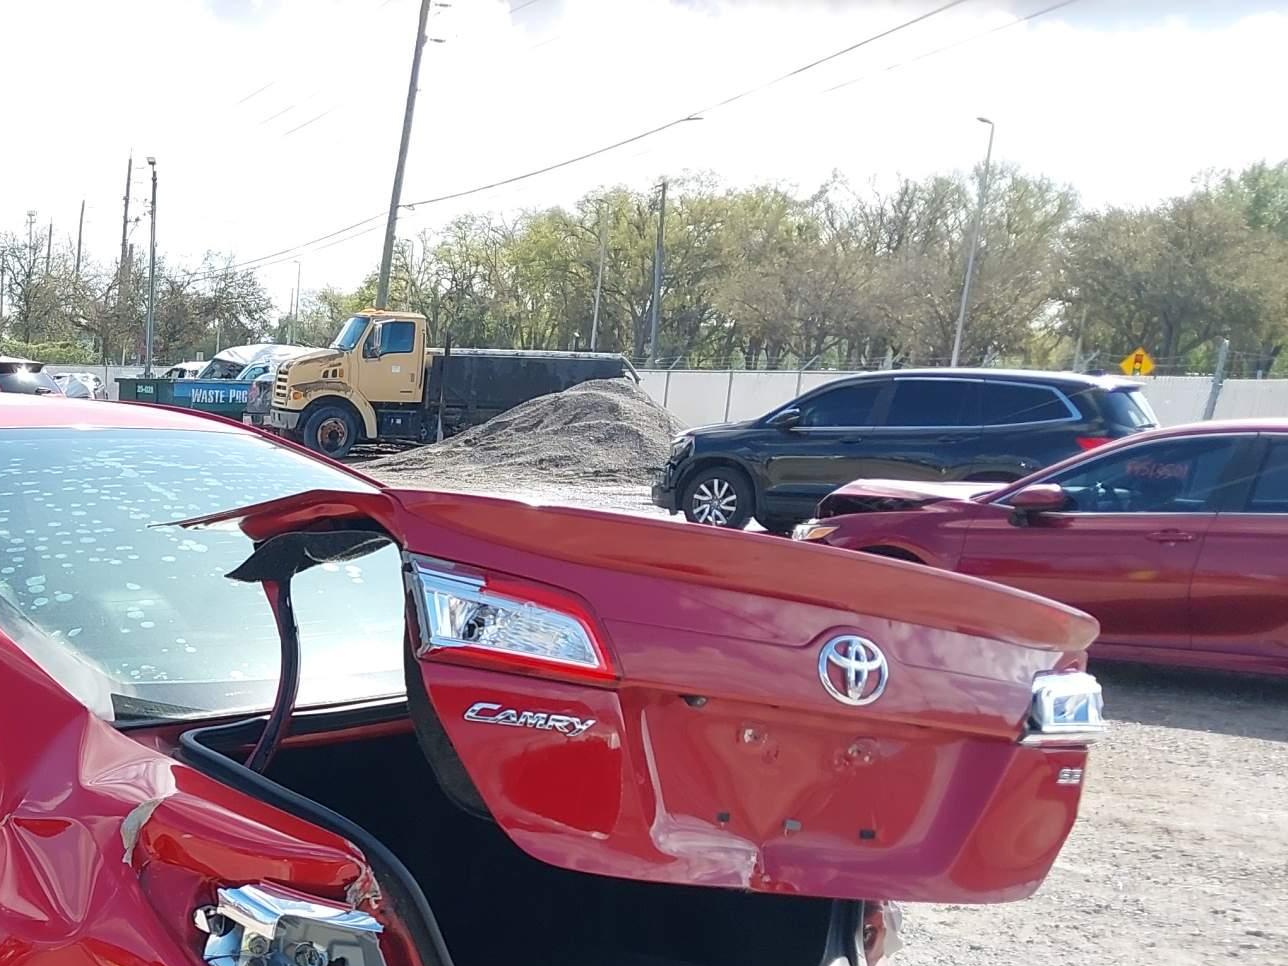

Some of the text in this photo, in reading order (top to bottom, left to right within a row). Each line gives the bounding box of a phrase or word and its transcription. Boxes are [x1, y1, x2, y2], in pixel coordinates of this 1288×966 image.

[191, 388, 225, 403] WASTE
[464, 702, 596, 737] CAMRY
[1056, 767, 1082, 784] SE
